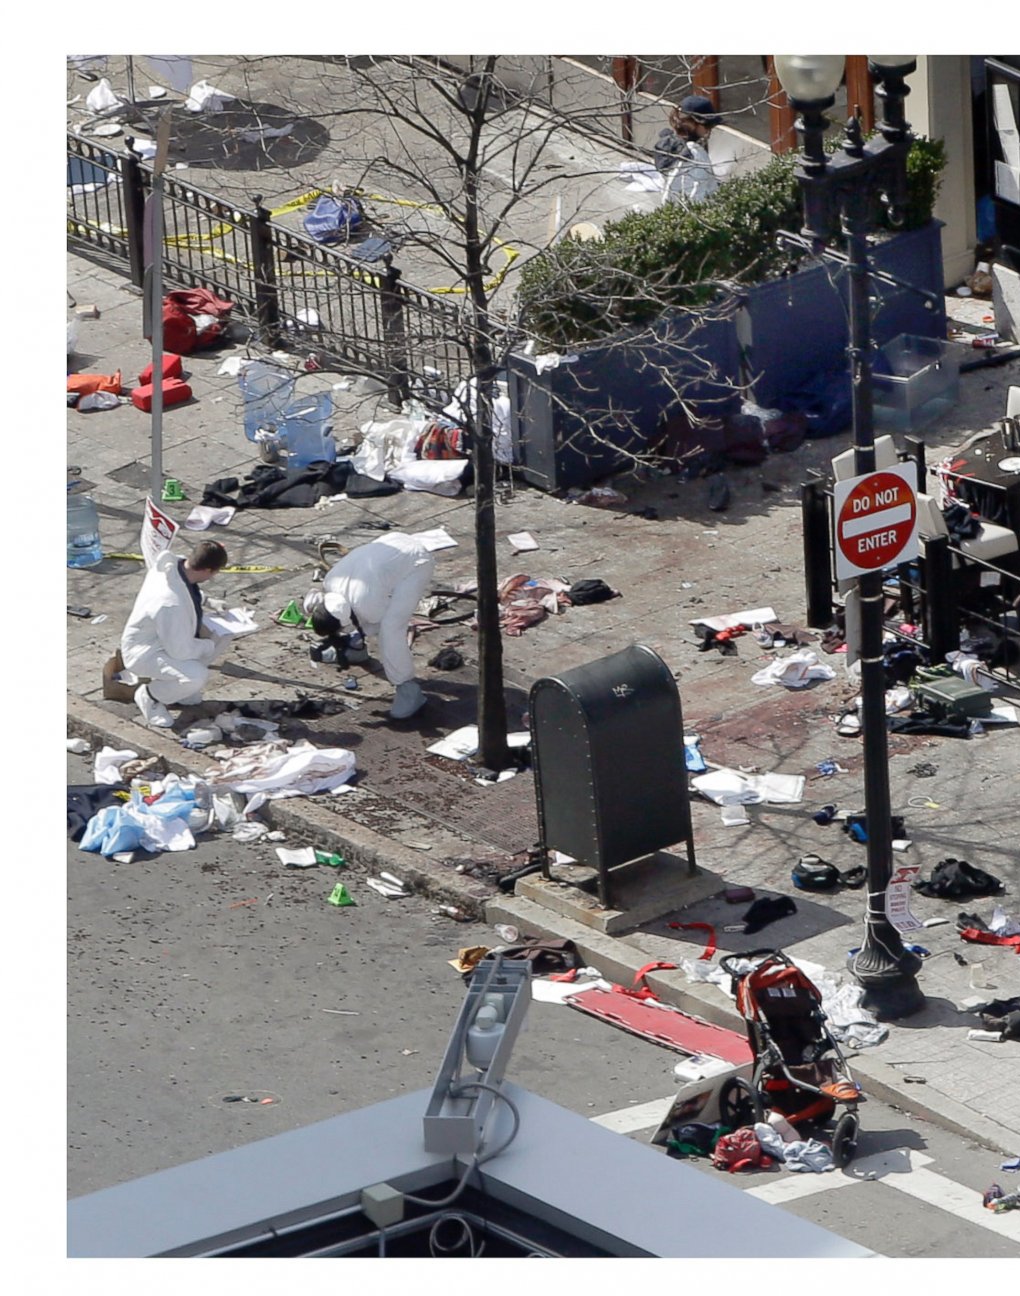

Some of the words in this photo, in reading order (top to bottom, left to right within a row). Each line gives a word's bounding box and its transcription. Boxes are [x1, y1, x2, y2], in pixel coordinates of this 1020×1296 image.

[169, 484, 176, 495] 3
[853, 496, 870, 513] DO
[875, 487, 899, 507] NOT
[858, 530, 897, 553] ENTER
